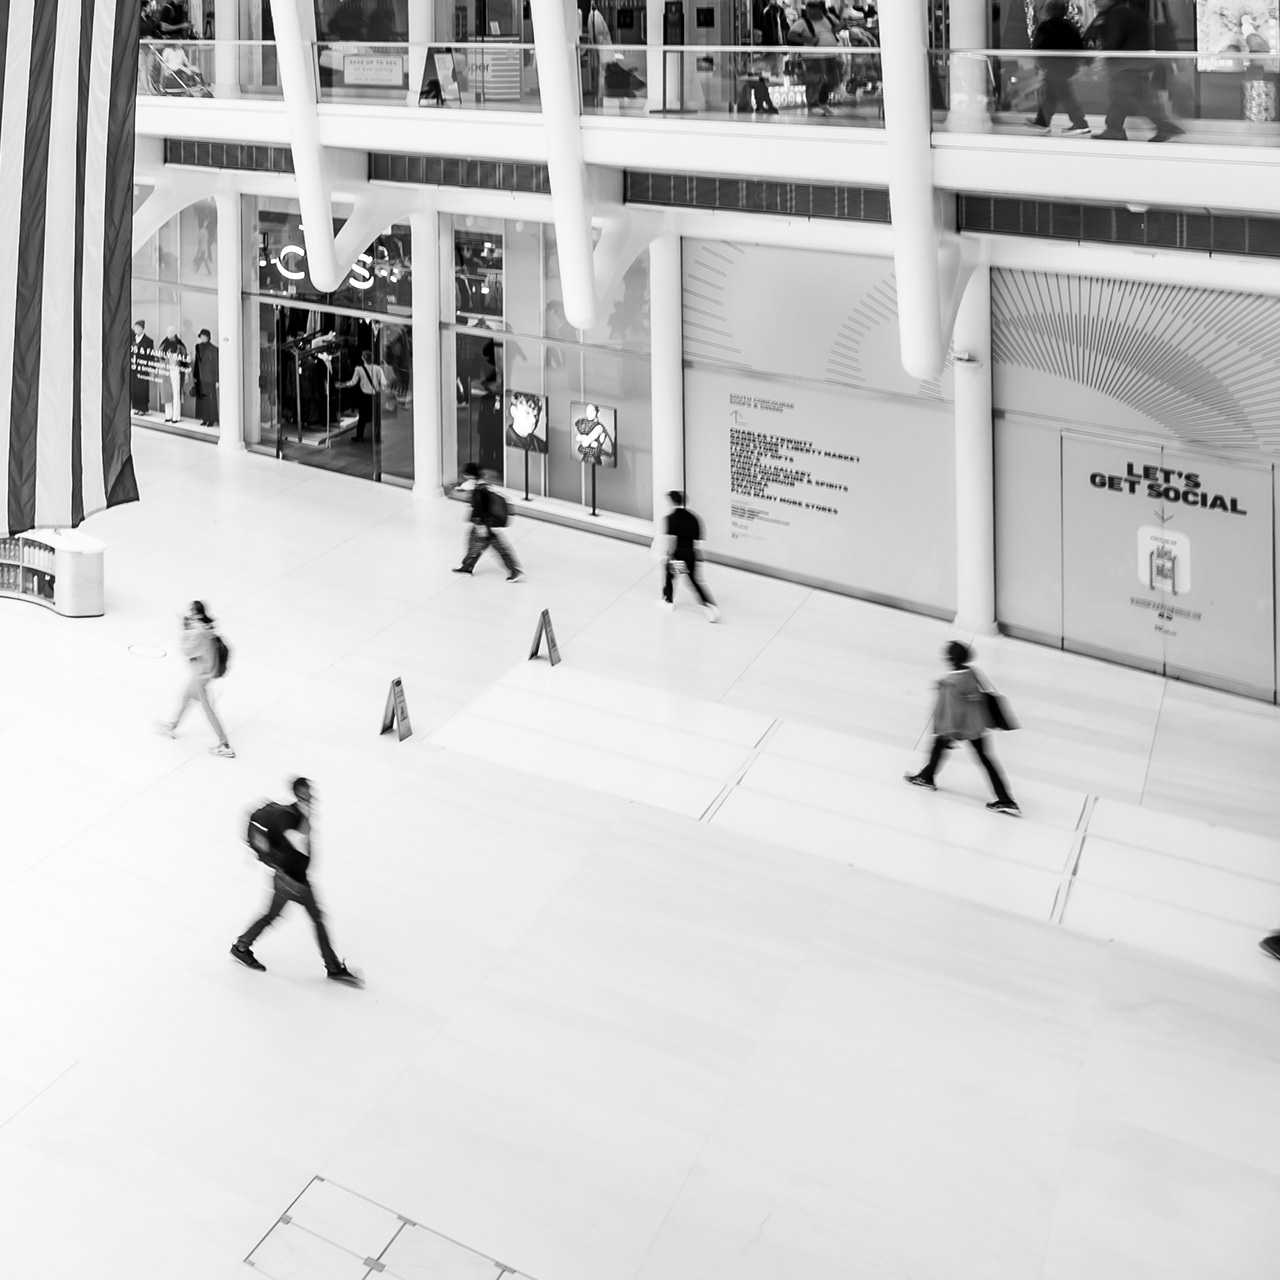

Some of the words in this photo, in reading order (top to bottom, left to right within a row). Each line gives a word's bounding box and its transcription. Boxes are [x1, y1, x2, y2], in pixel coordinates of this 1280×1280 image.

[276, 244, 375, 290] CS
[146, 347, 171, 359] FAMILY
[173, 352, 192, 364] SALE
[824, 449, 861, 464] MARKET
[815, 480, 849, 493] SPIRITS
[1126, 461, 1202, 489] LET'S
[753, 492, 778, 504] MANY
[779, 497, 803, 509] MORE
[804, 501, 839, 517] STORES
[1090, 471, 1142, 495] GET
[1146, 481, 1248, 517] SOCIAL
